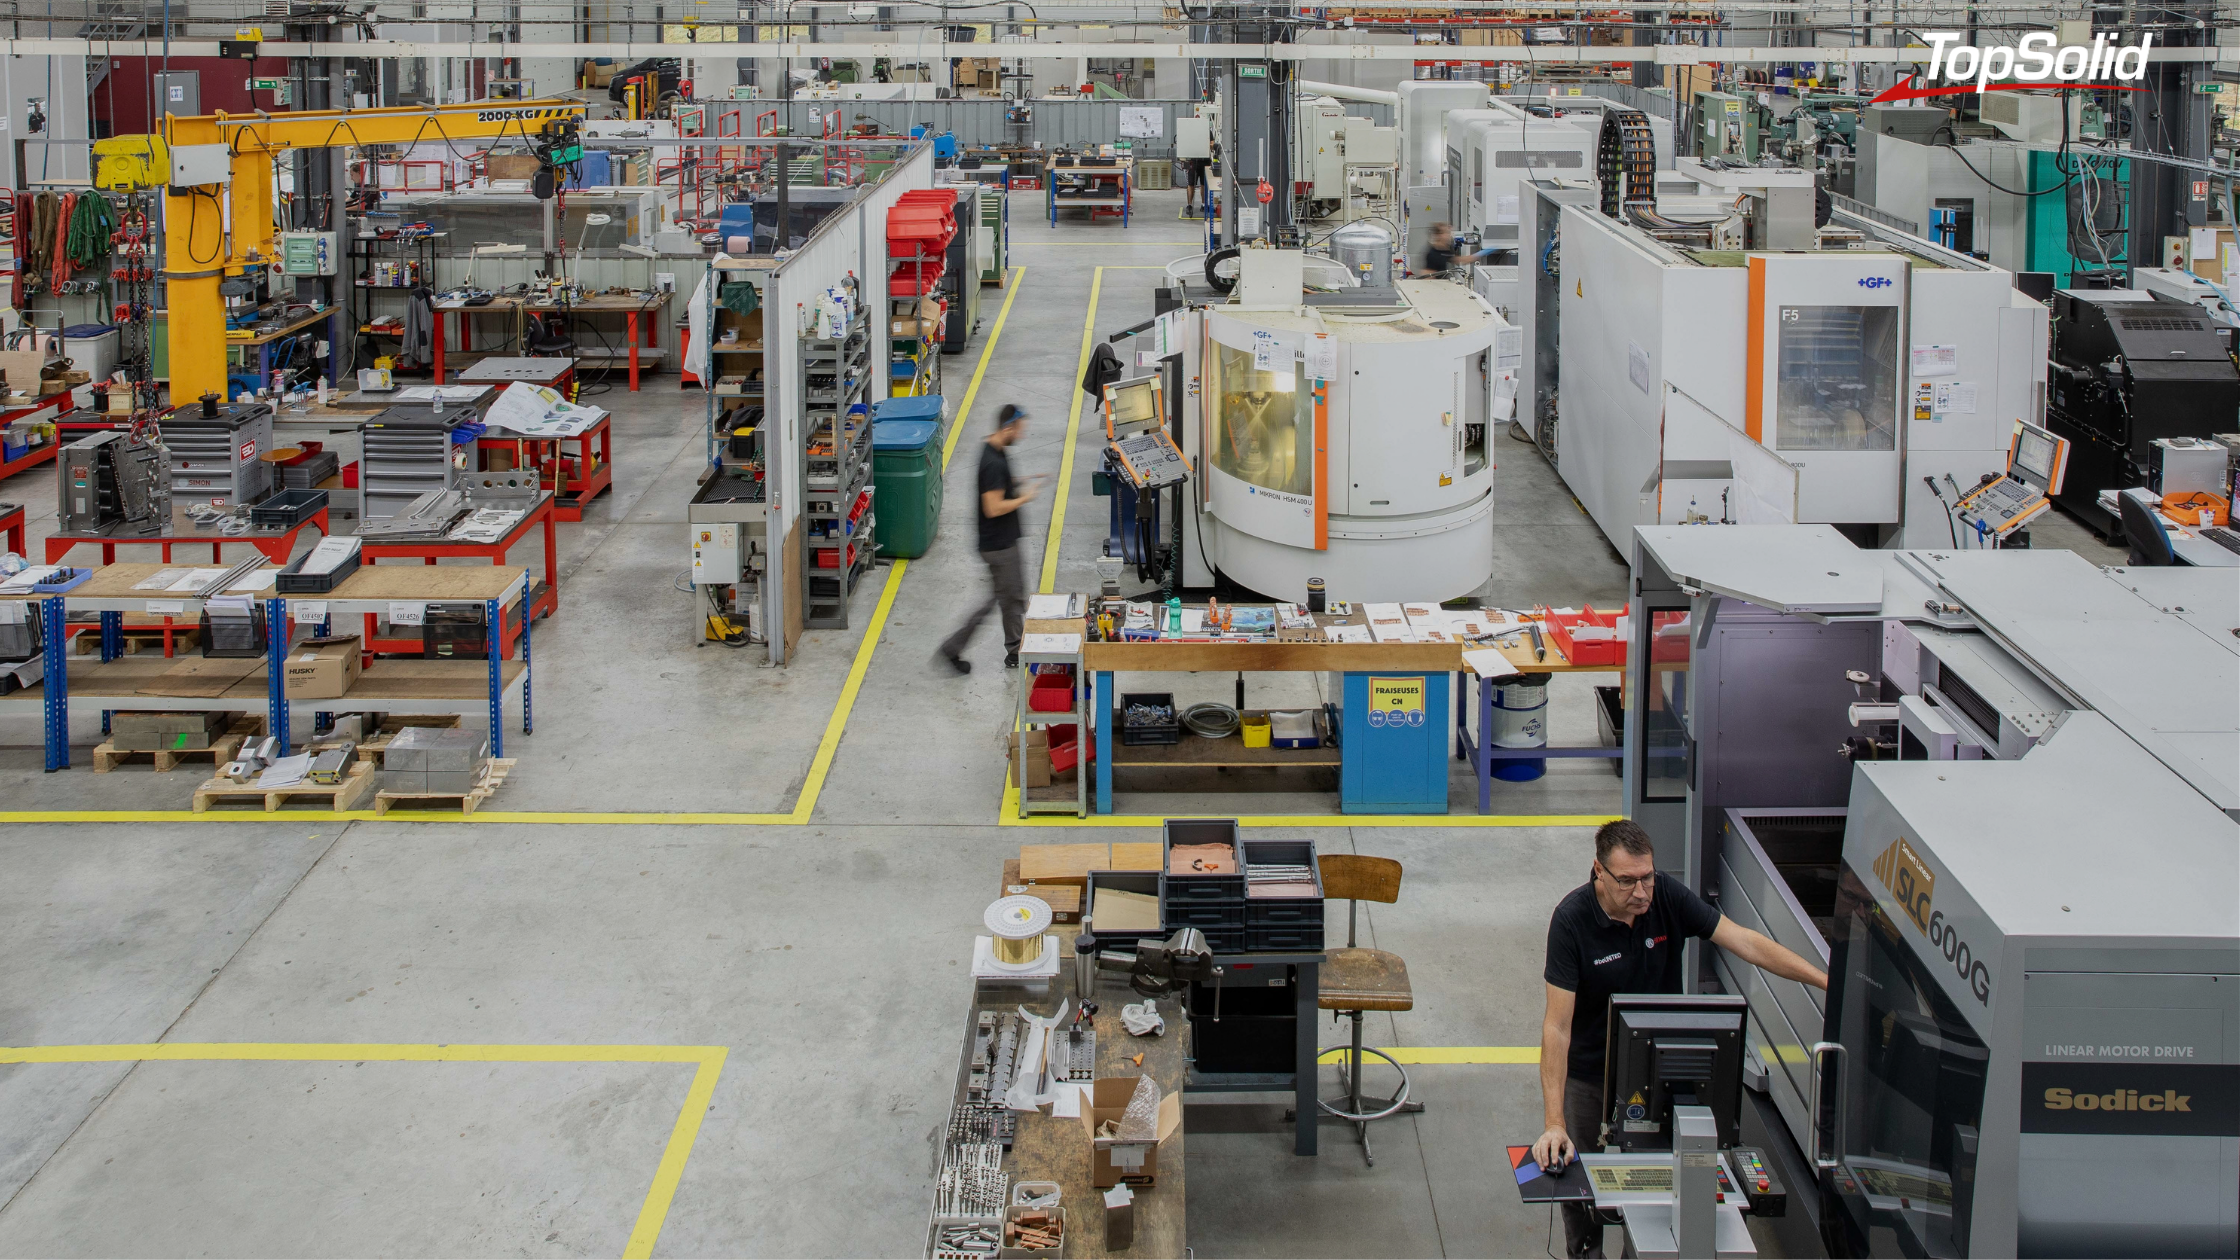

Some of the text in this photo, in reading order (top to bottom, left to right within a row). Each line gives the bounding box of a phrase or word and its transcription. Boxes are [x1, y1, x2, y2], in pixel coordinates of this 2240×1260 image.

[478, 111, 510, 122] 2000
[1782, 309, 1799, 321] F5
[1259, 490, 1281, 501] MIKRON
[1283, 495, 1296, 504] HSM
[1522, 723, 1541, 731] FUCHS
[1901, 843, 1932, 883] Smart Linear
[2045, 1045, 2194, 1058] LINEAR MOTOR DRIVE
[2044, 1087, 2192, 1112] Sodick
